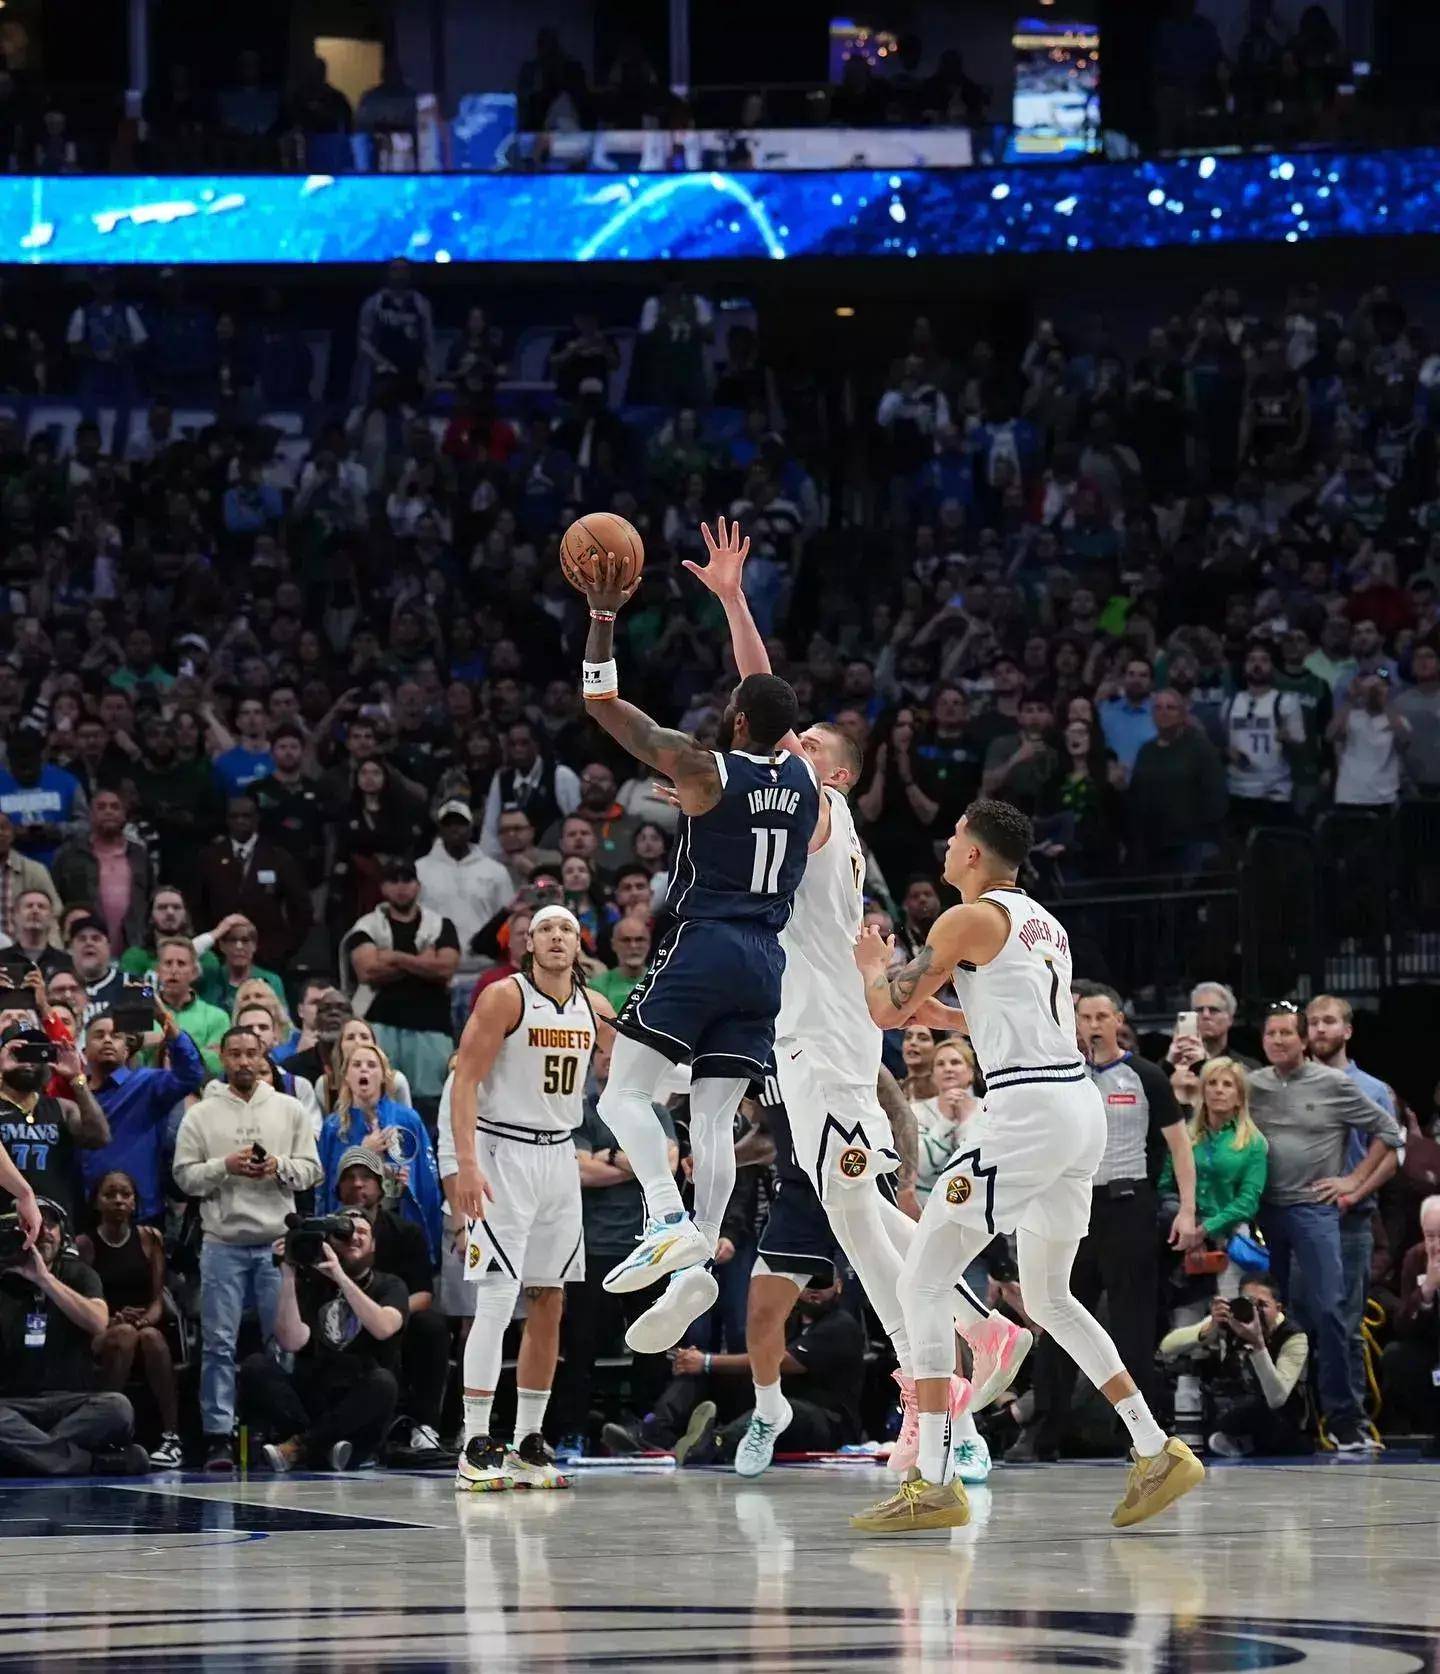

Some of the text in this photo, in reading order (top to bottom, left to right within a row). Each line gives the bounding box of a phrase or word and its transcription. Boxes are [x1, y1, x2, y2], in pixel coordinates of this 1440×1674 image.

[748, 788, 801, 815] IRVING
[751, 827, 789, 894] 11
[1019, 918, 1052, 952] PORTER
[1044, 958, 1061, 1028] 1
[528, 1027, 591, 1050] NUGGETS
[543, 1055, 579, 1096] 50
[12, 1143, 49, 1171] 77
